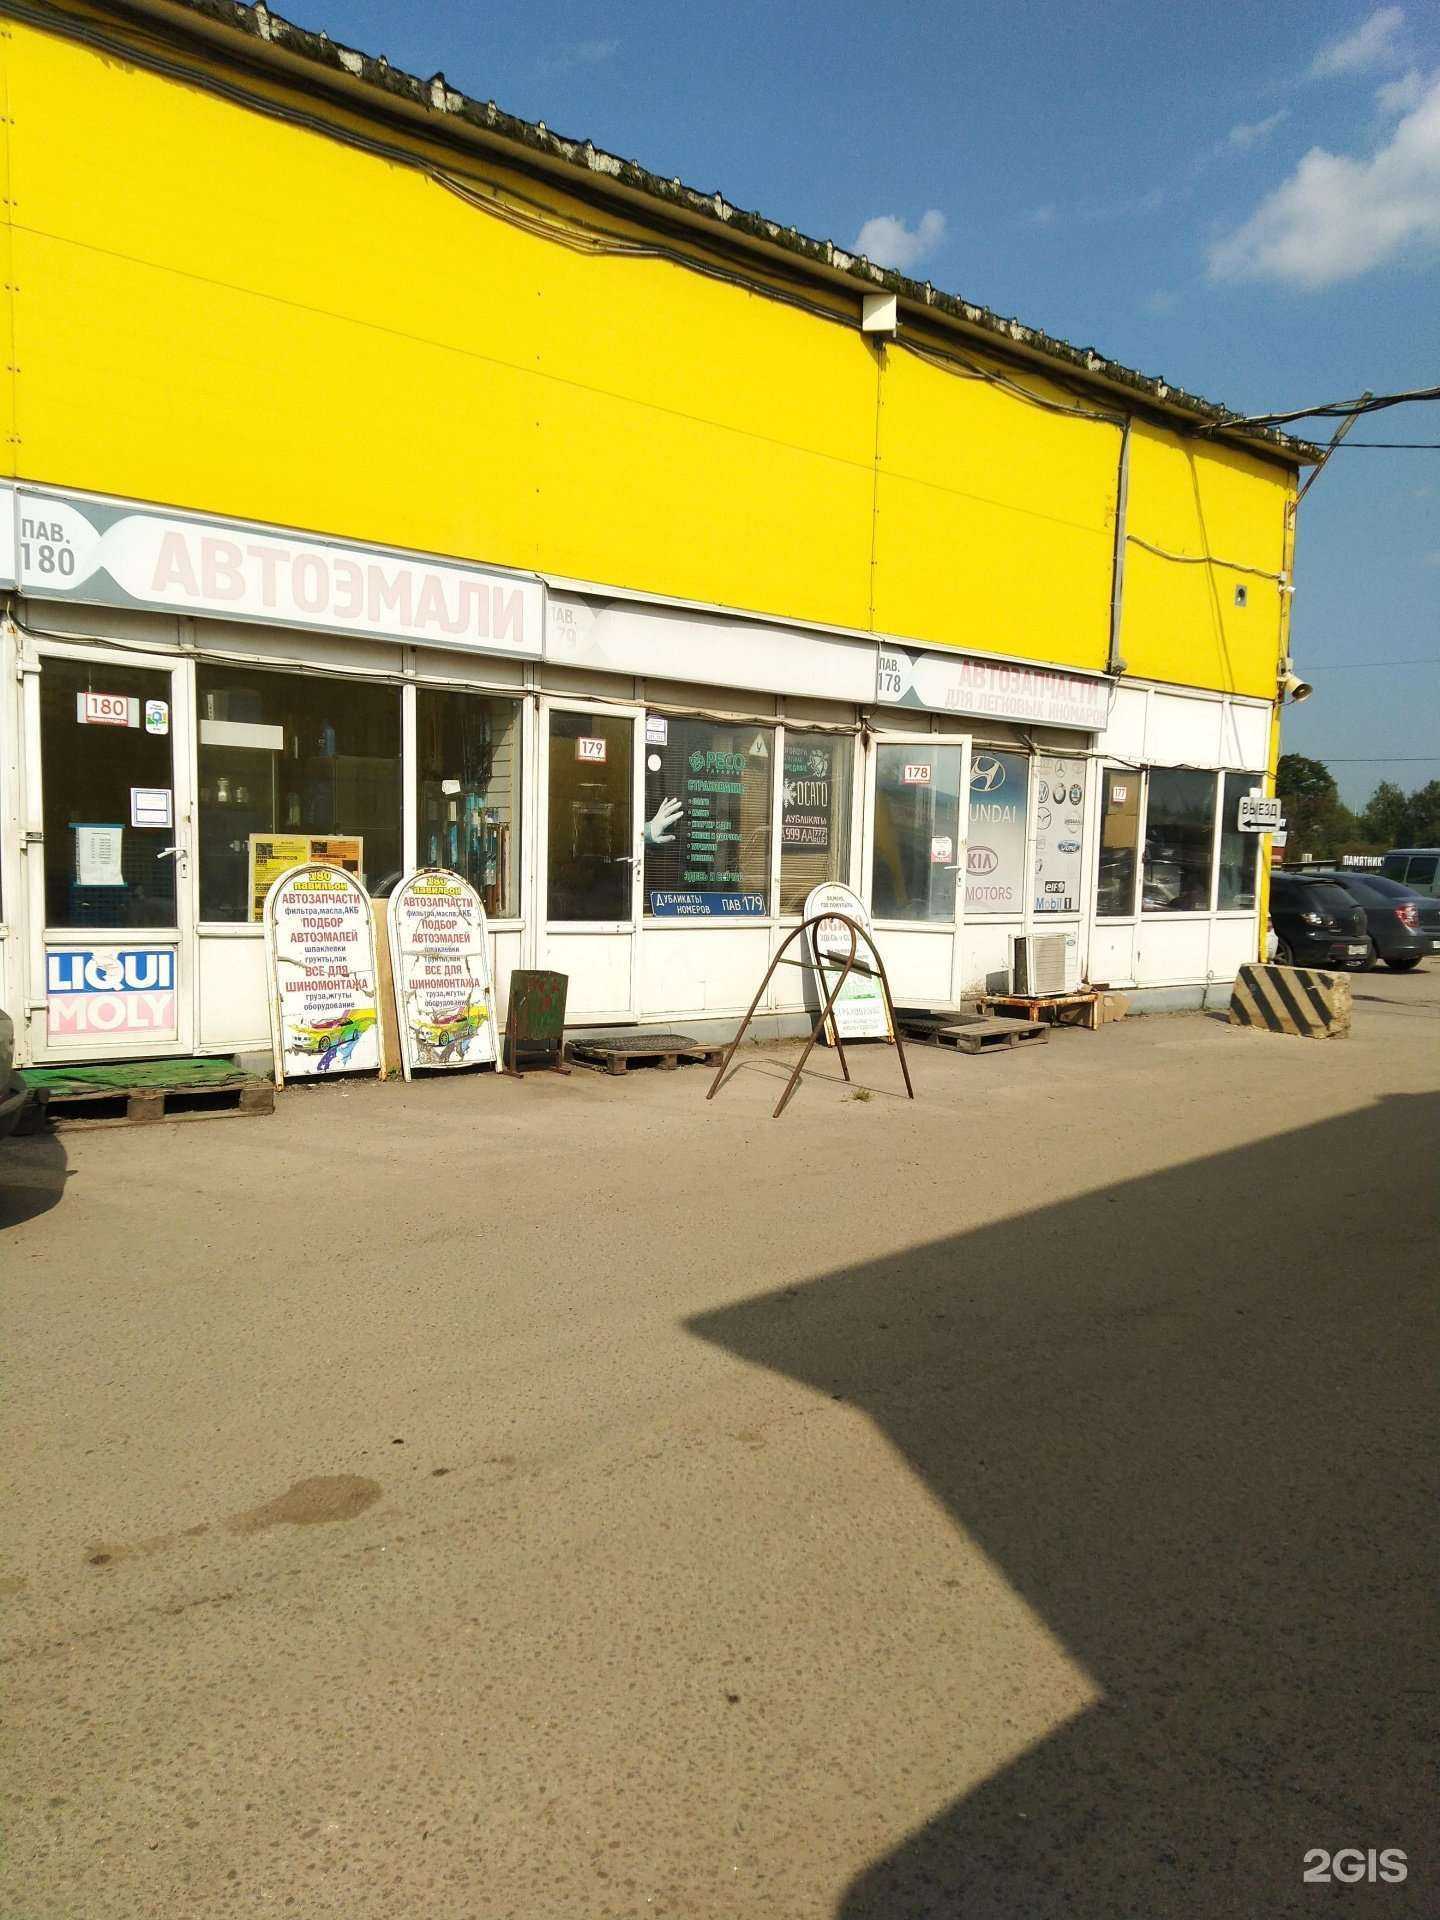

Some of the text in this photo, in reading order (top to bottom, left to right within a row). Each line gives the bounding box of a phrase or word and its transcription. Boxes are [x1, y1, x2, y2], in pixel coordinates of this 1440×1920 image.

[21, 518, 70, 544] ПАВ.
[20, 542, 75, 576] 180
[150, 531, 524, 642] АВТОЭМАЛИ
[879, 657, 900, 673] ПАВ.
[878, 673, 901, 693] 178
[959, 657, 1100, 705] АВТОЗАПЧАСТИ
[91, 698, 124, 716] 180
[945, 689, 973, 708] ДЛЯ
[977, 693, 1044, 717] ЛЕГКОВЫХ
[582, 741, 603, 755] 179
[706, 751, 745, 770] РЕСО
[907, 766, 928, 779] 178
[797, 781, 828, 807] ОСАГО
[969, 804, 1016, 824] UNDAI
[1242, 802, 1278, 817] ВЫЕЗД
[785, 814, 827, 825] ДУБЛИКАТЫ
[968, 853, 992, 869] KIA
[1342, 855, 1385, 867] ПАМЯТНИК
[309, 871, 332, 881] 180
[293, 882, 348, 891] павильон
[966, 886, 1013, 900] MOTORS
[282, 893, 361, 904] АВТОЗАПЧАСТИ
[404, 897, 473, 907] АВТОЗАПЧАСТИ
[656, 894, 703, 906] ДУБЛИКАТЫ
[743, 896, 763, 911] 179
[1036, 897, 1062, 910] Mobil
[677, 905, 711, 914] НОМЕРОВ
[302, 917, 343, 929] ПОДБОР
[422, 920, 457, 931] ПОДБОР
[290, 929, 358, 943] АВТОЭМАЛЕЙ
[412, 931, 471, 943] АВТОЭМАЛЕЙ
[49, 954, 170, 991] LIQUI
[305, 965, 348, 977] ВСЕ ДЛЯ
[425, 965, 462, 976] ВСЕ ДЛЯ
[285, 979, 368, 992] ШИНОМОНТАЖА
[409, 978, 480, 989] ШИНОМОНТАЖА
[50, 994, 173, 1032] MOLY
[304, 1002, 355, 1011] оборудование
